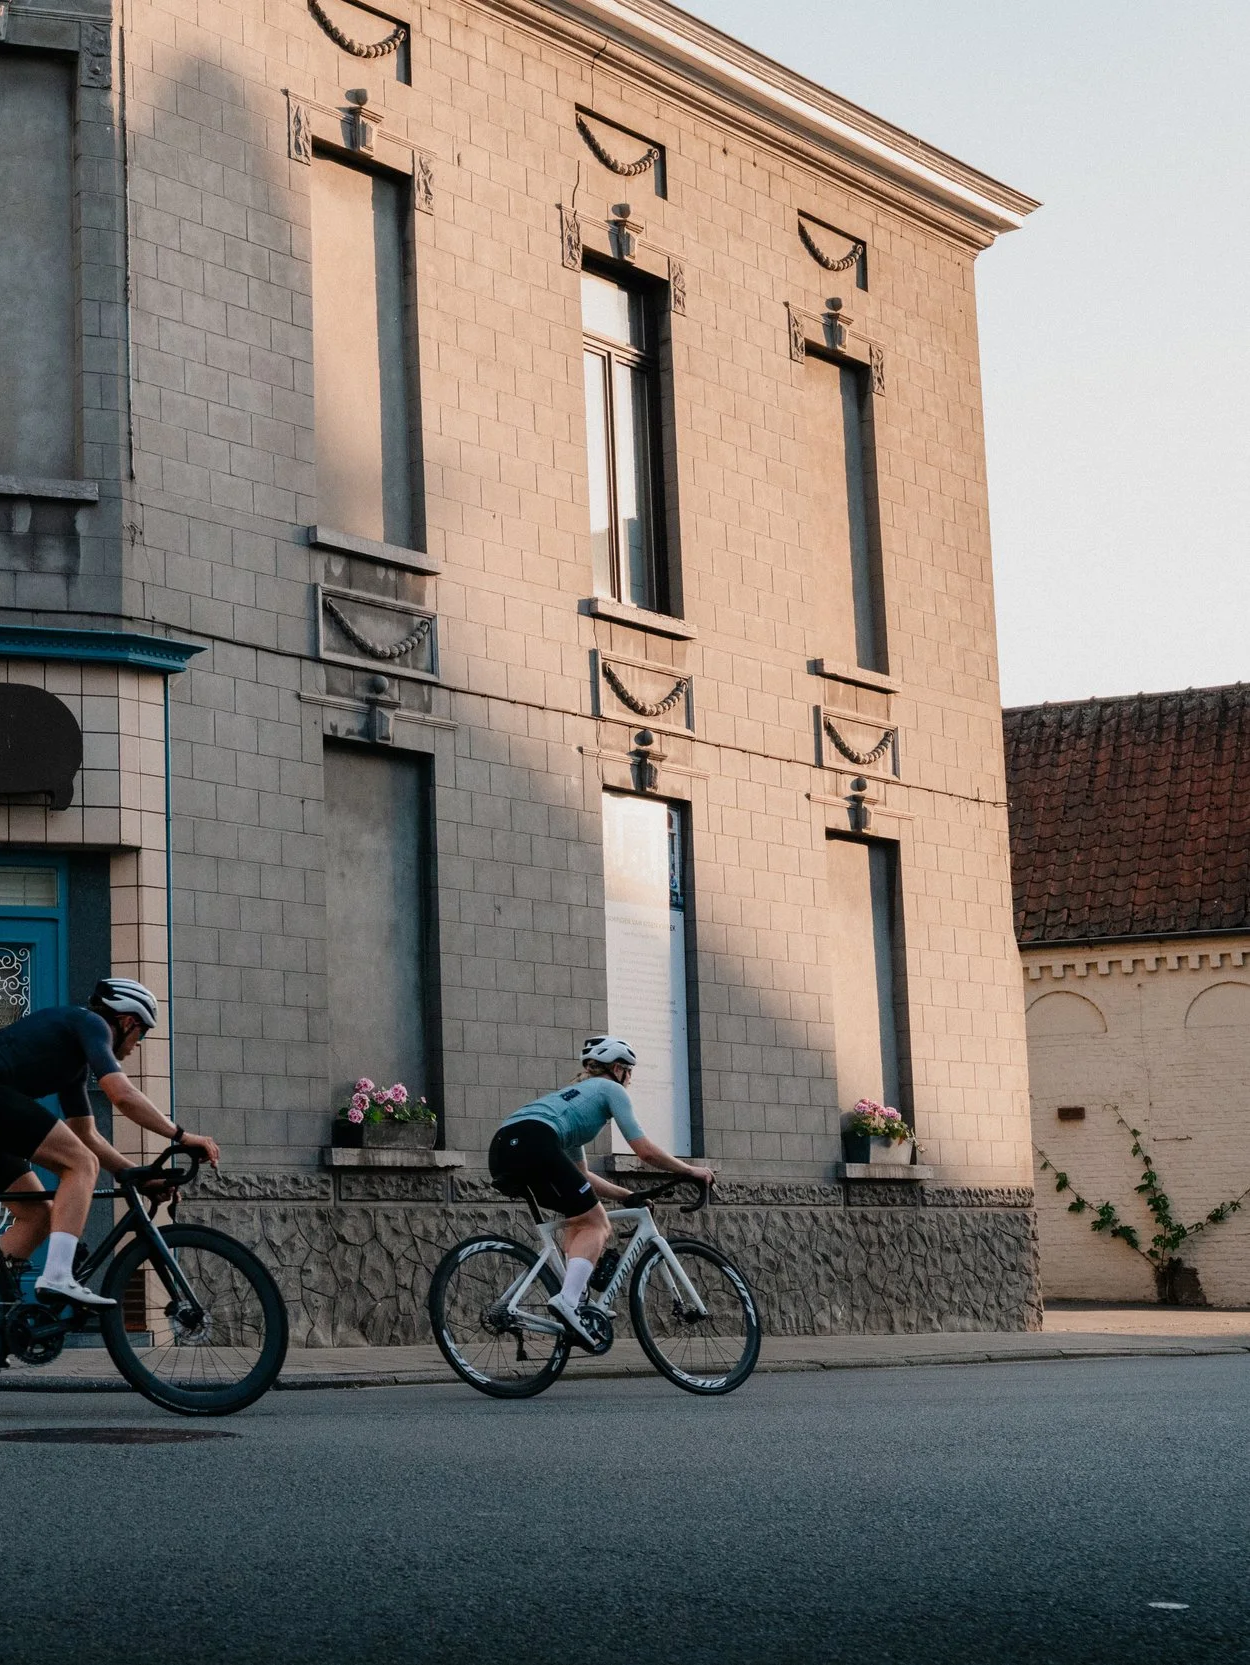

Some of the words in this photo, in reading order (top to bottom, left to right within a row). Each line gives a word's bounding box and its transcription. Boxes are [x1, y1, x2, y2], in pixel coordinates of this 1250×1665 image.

[458, 1240, 515, 1263] ZIPP
[603, 1237, 644, 1307] SPECIALIZED
[722, 1266, 757, 1327] ZIPP
[442, 1329, 492, 1384] ZIPP
[672, 1369, 728, 1388] ZIPP
